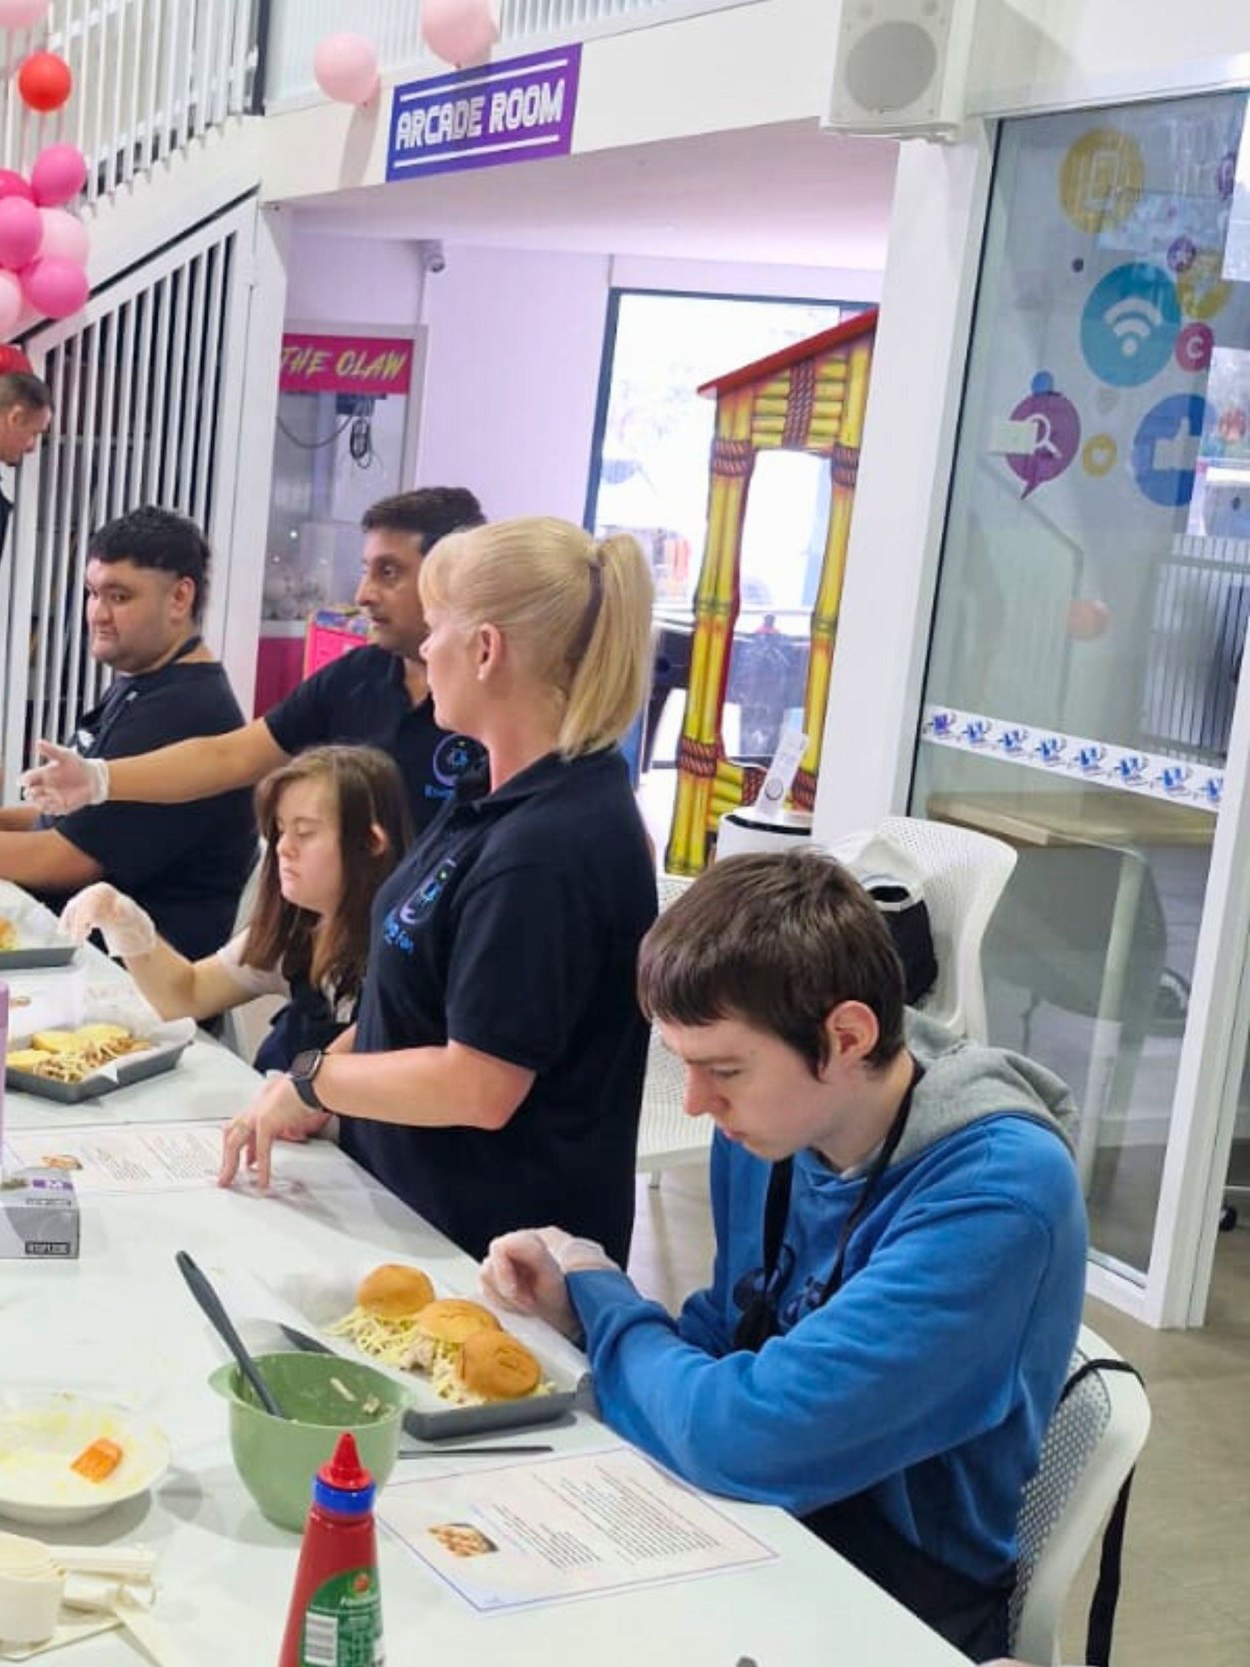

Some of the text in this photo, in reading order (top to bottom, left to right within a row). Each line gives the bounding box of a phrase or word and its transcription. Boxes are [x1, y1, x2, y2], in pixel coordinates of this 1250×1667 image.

[396, 78, 565, 150] ARCADE ROOM
[282, 345, 332, 379] THE
